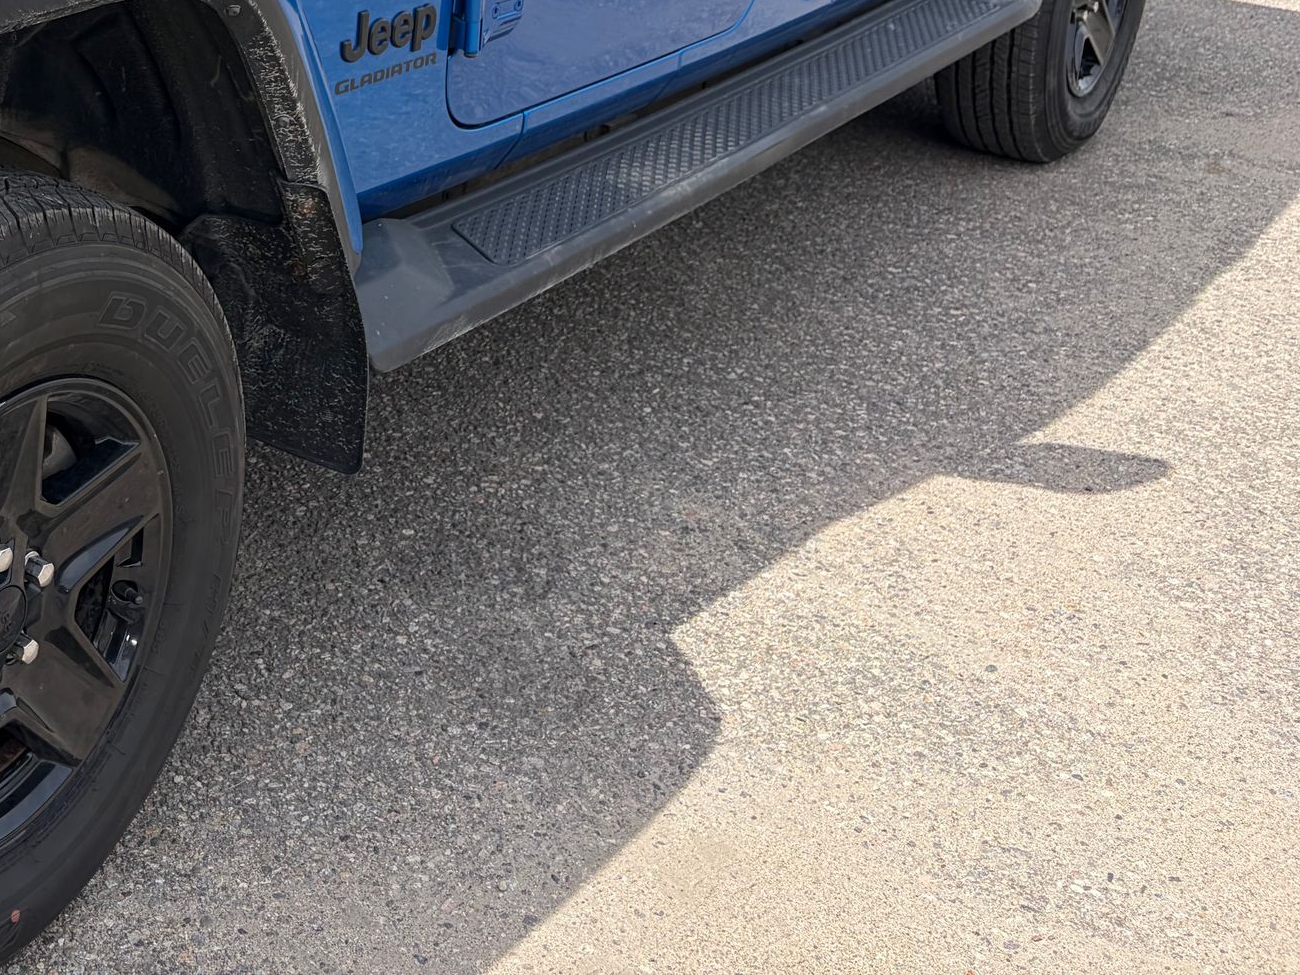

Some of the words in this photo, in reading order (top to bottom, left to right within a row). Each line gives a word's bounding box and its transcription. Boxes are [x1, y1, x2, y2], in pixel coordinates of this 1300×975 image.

[340, 2, 437, 63] Jeep
[334, 52, 437, 95] GLADIATOR
[98, 291, 236, 546] DUELER
